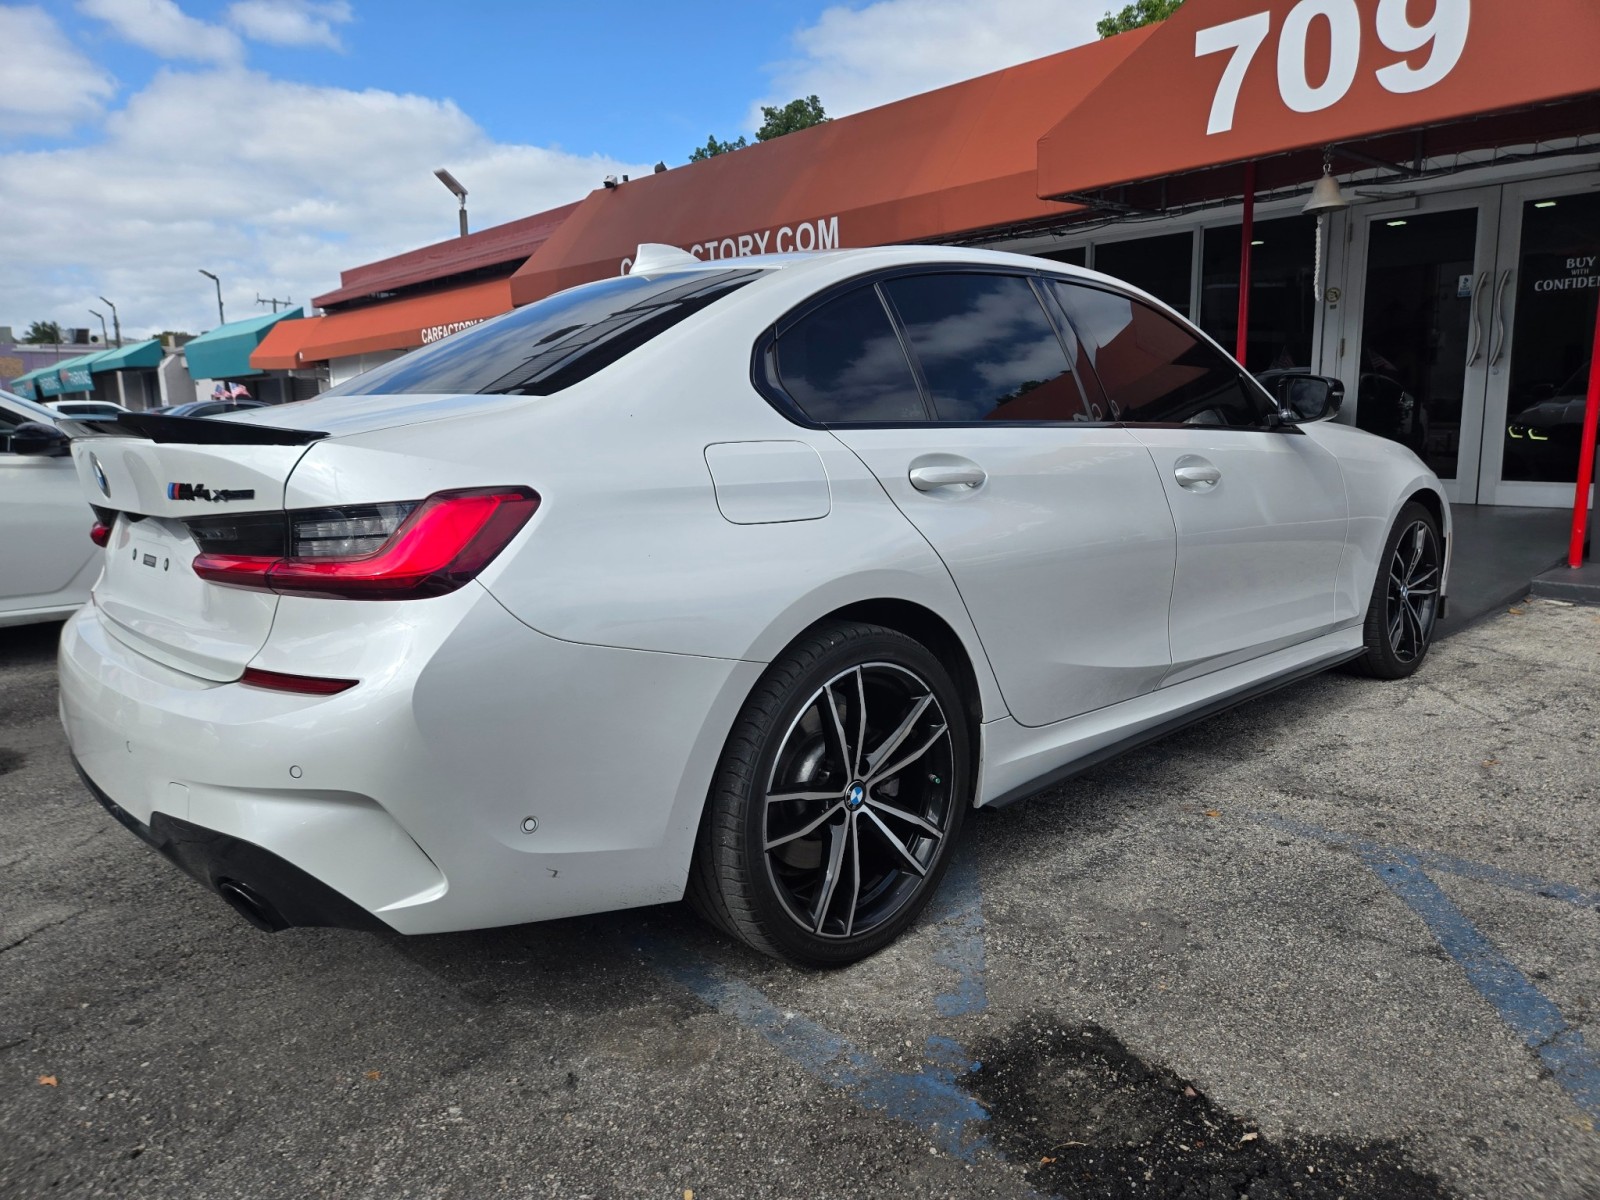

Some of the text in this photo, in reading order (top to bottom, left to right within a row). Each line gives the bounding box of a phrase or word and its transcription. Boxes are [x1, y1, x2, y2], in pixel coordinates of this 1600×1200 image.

[1195, 0, 1471, 135] 709
[1566, 255, 1596, 269] BUY
[1571, 268, 1589, 276] WITH
